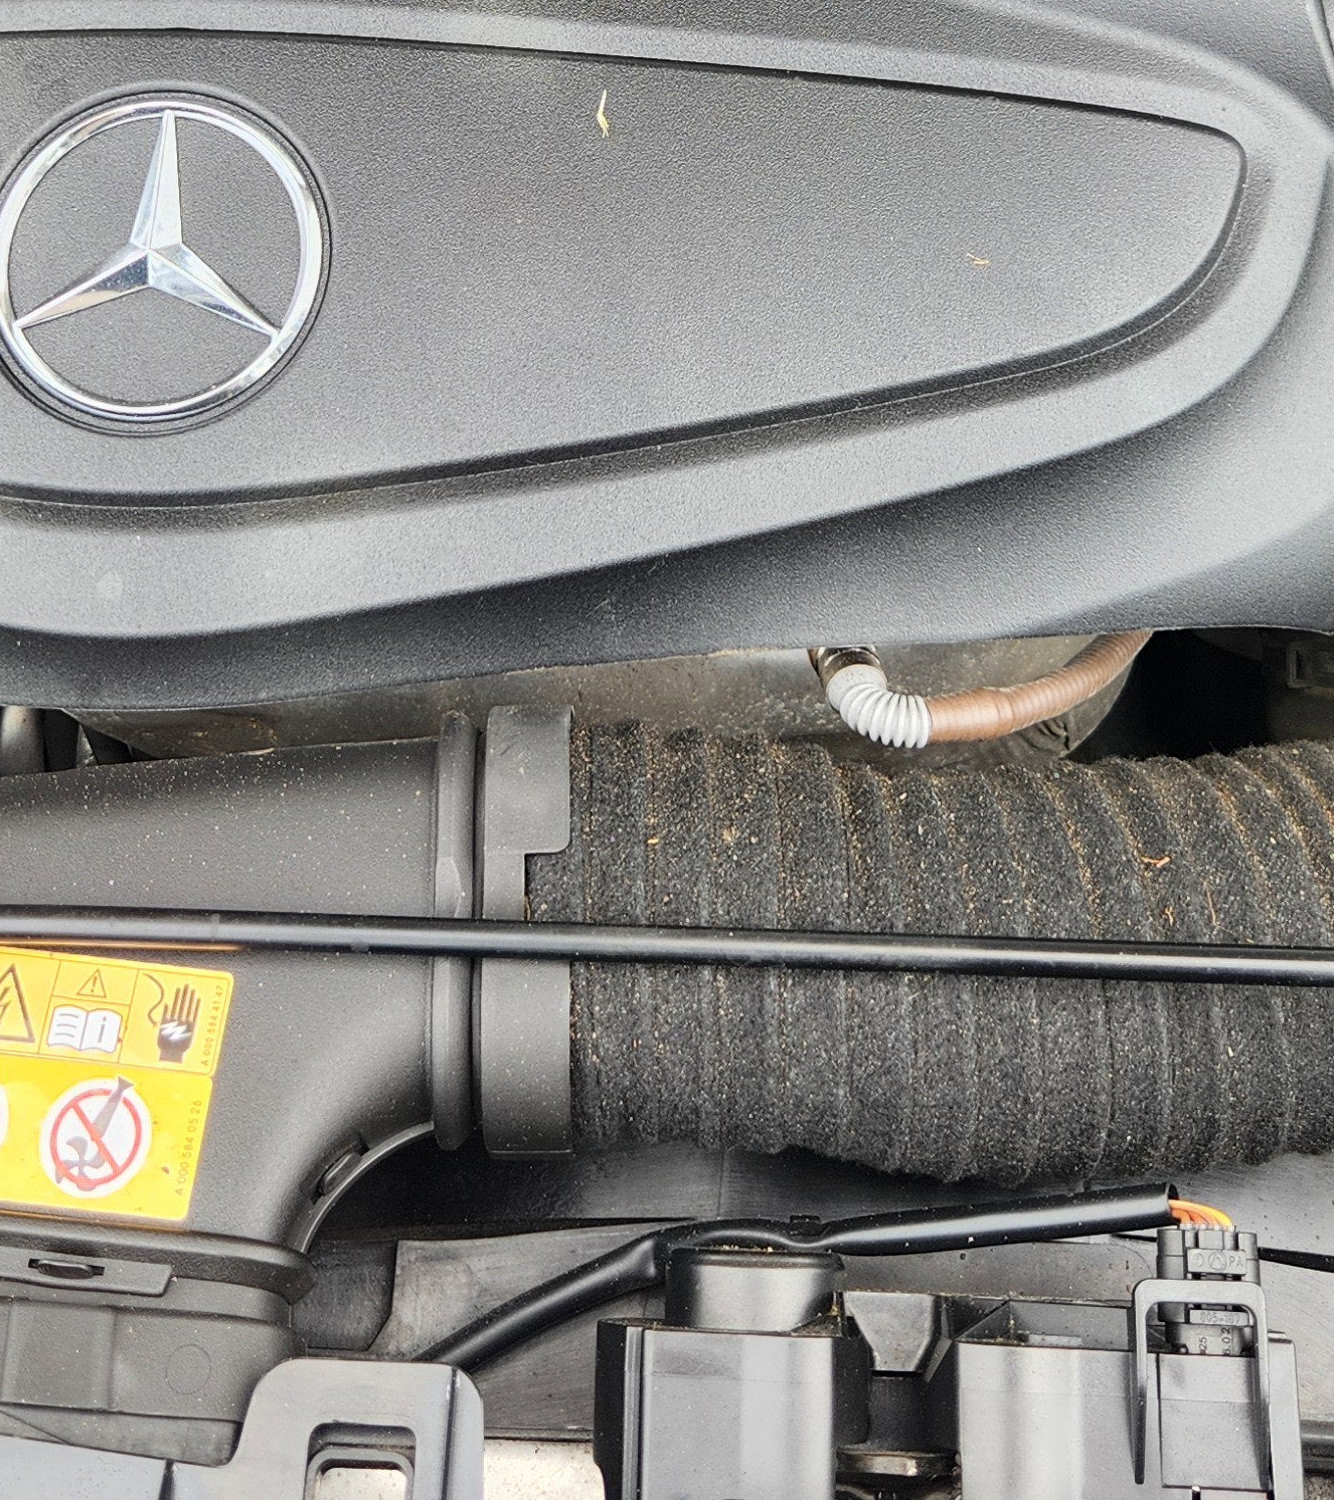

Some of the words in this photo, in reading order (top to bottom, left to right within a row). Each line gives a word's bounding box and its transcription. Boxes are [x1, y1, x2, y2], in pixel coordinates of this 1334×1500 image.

[202, 1035, 214, 1056] 000
[193, 1098, 204, 1115] 26
[188, 1116, 200, 1134] 05
[183, 1135, 195, 1160] 584
[177, 1160, 189, 1185] 000
[175, 1186, 184, 1197] A
